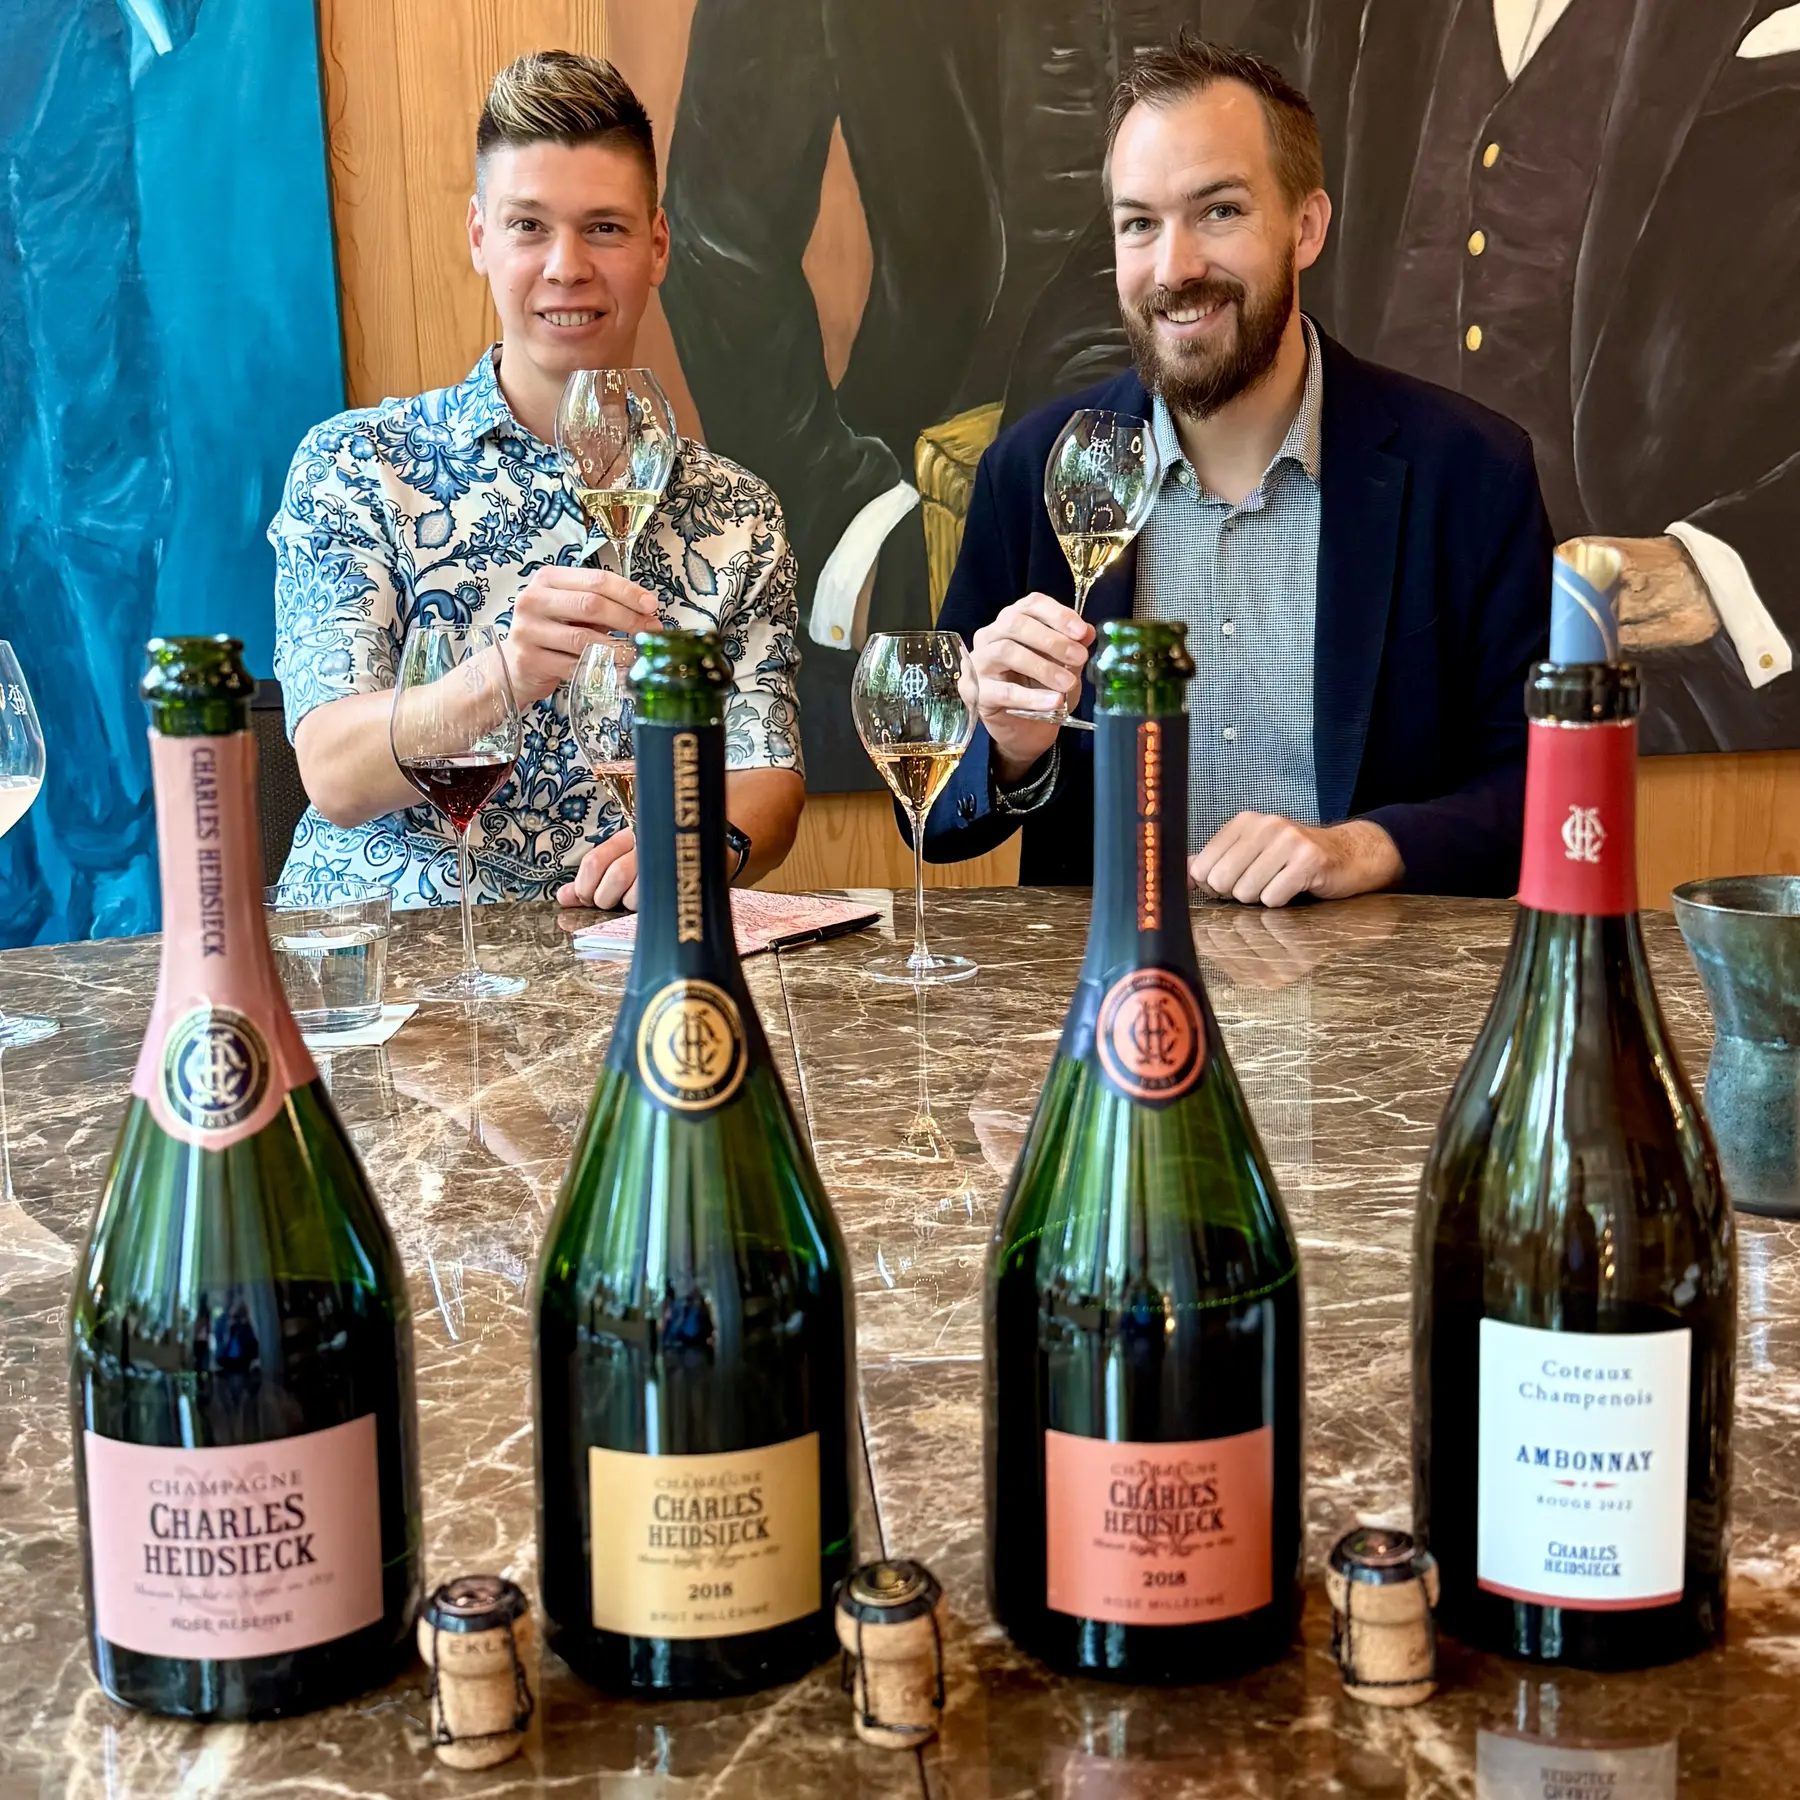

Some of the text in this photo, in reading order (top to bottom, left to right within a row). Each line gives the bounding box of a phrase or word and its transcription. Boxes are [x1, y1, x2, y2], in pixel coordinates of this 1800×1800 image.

[192, 747, 225, 958] CHARLES HEIDSIECK
[1542, 1360, 1633, 1381] Coteaux
[1519, 1382, 1654, 1410] Champenois
[1516, 1445, 1653, 1472] AMBONNAY
[149, 1469, 302, 1496] CHAMPAGNE
[1109, 1478, 1219, 1512] CHARLES
[150, 1493, 306, 1540] CHARLES
[653, 1487, 764, 1522] CHARLES
[648, 1516, 771, 1549] HEIDSIECK
[1103, 1507, 1224, 1536] HEIDSIECK
[143, 1533, 318, 1578] HEIDSIECK
[1548, 1541, 1618, 1561] CHARLES
[1142, 1571, 1186, 1587] 2018
[1544, 1559, 1621, 1577] HEIDSIECK
[688, 1582, 734, 1600] 2018
